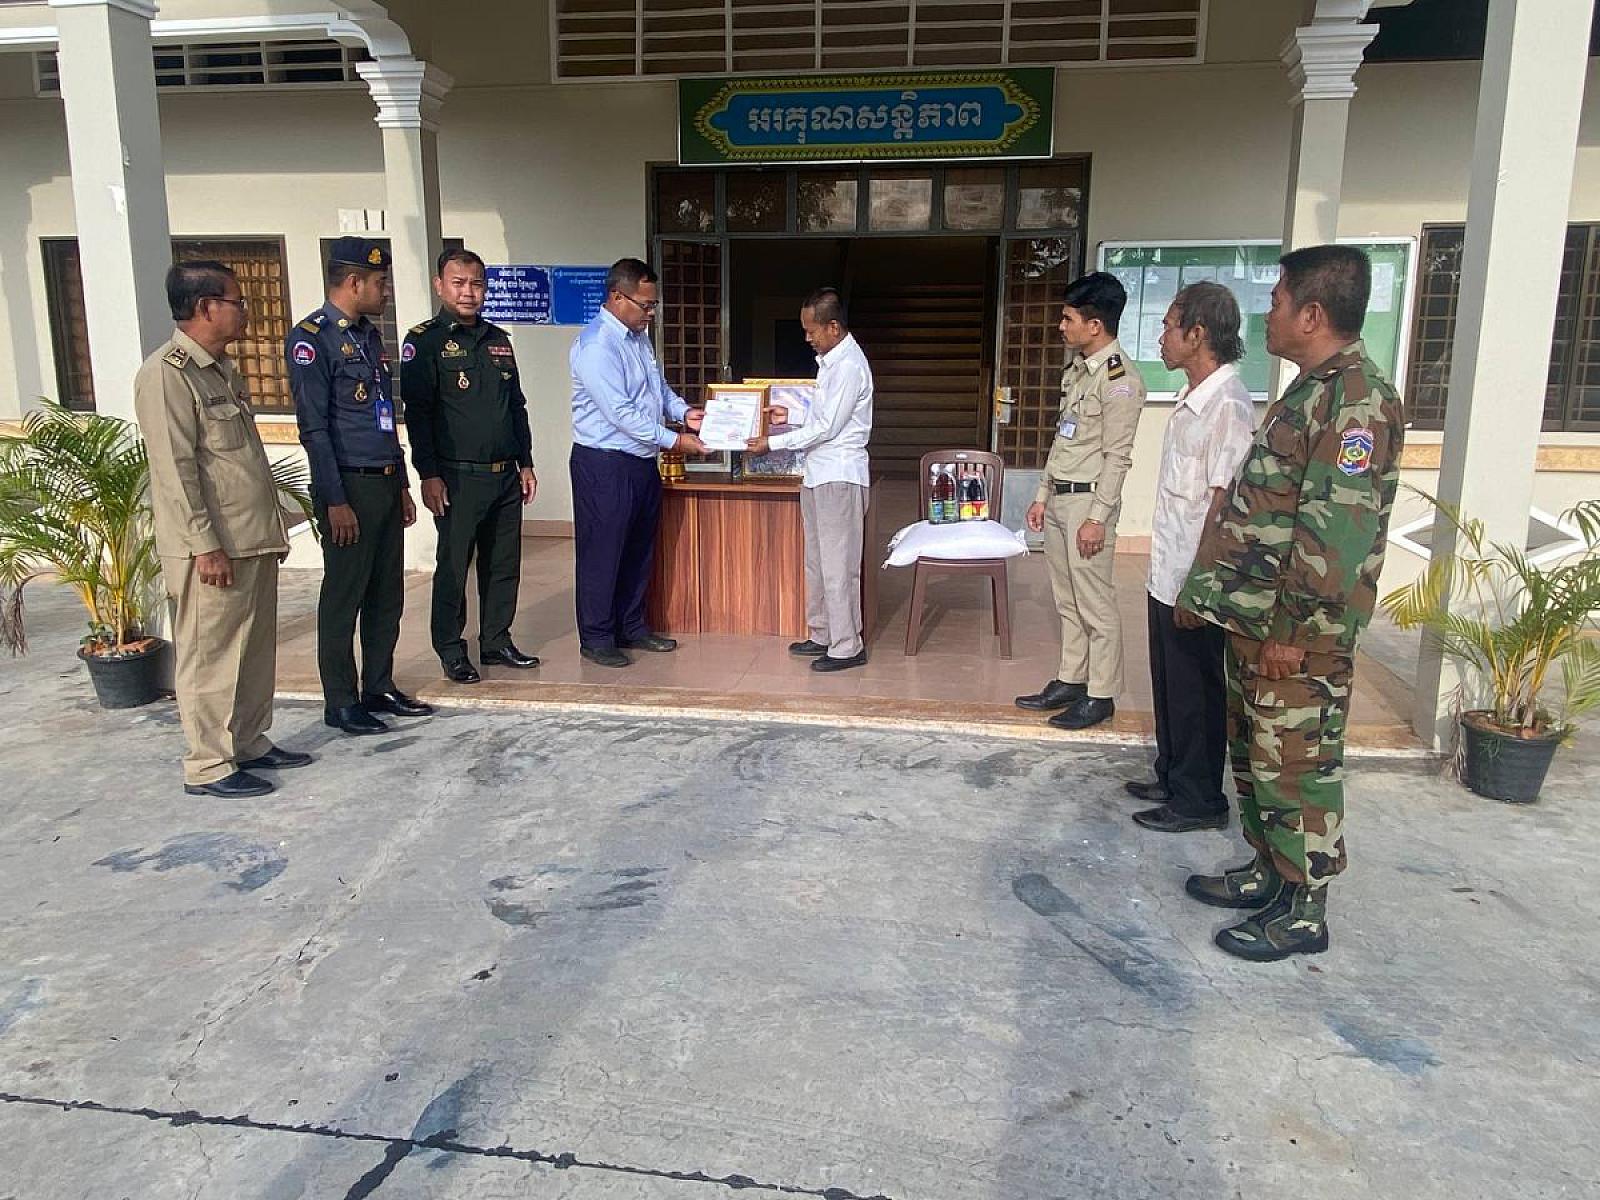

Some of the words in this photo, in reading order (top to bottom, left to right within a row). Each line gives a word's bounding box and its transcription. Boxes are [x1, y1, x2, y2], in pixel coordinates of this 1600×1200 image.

[748, 91, 982, 144] អរគុណសន្តិភាព
